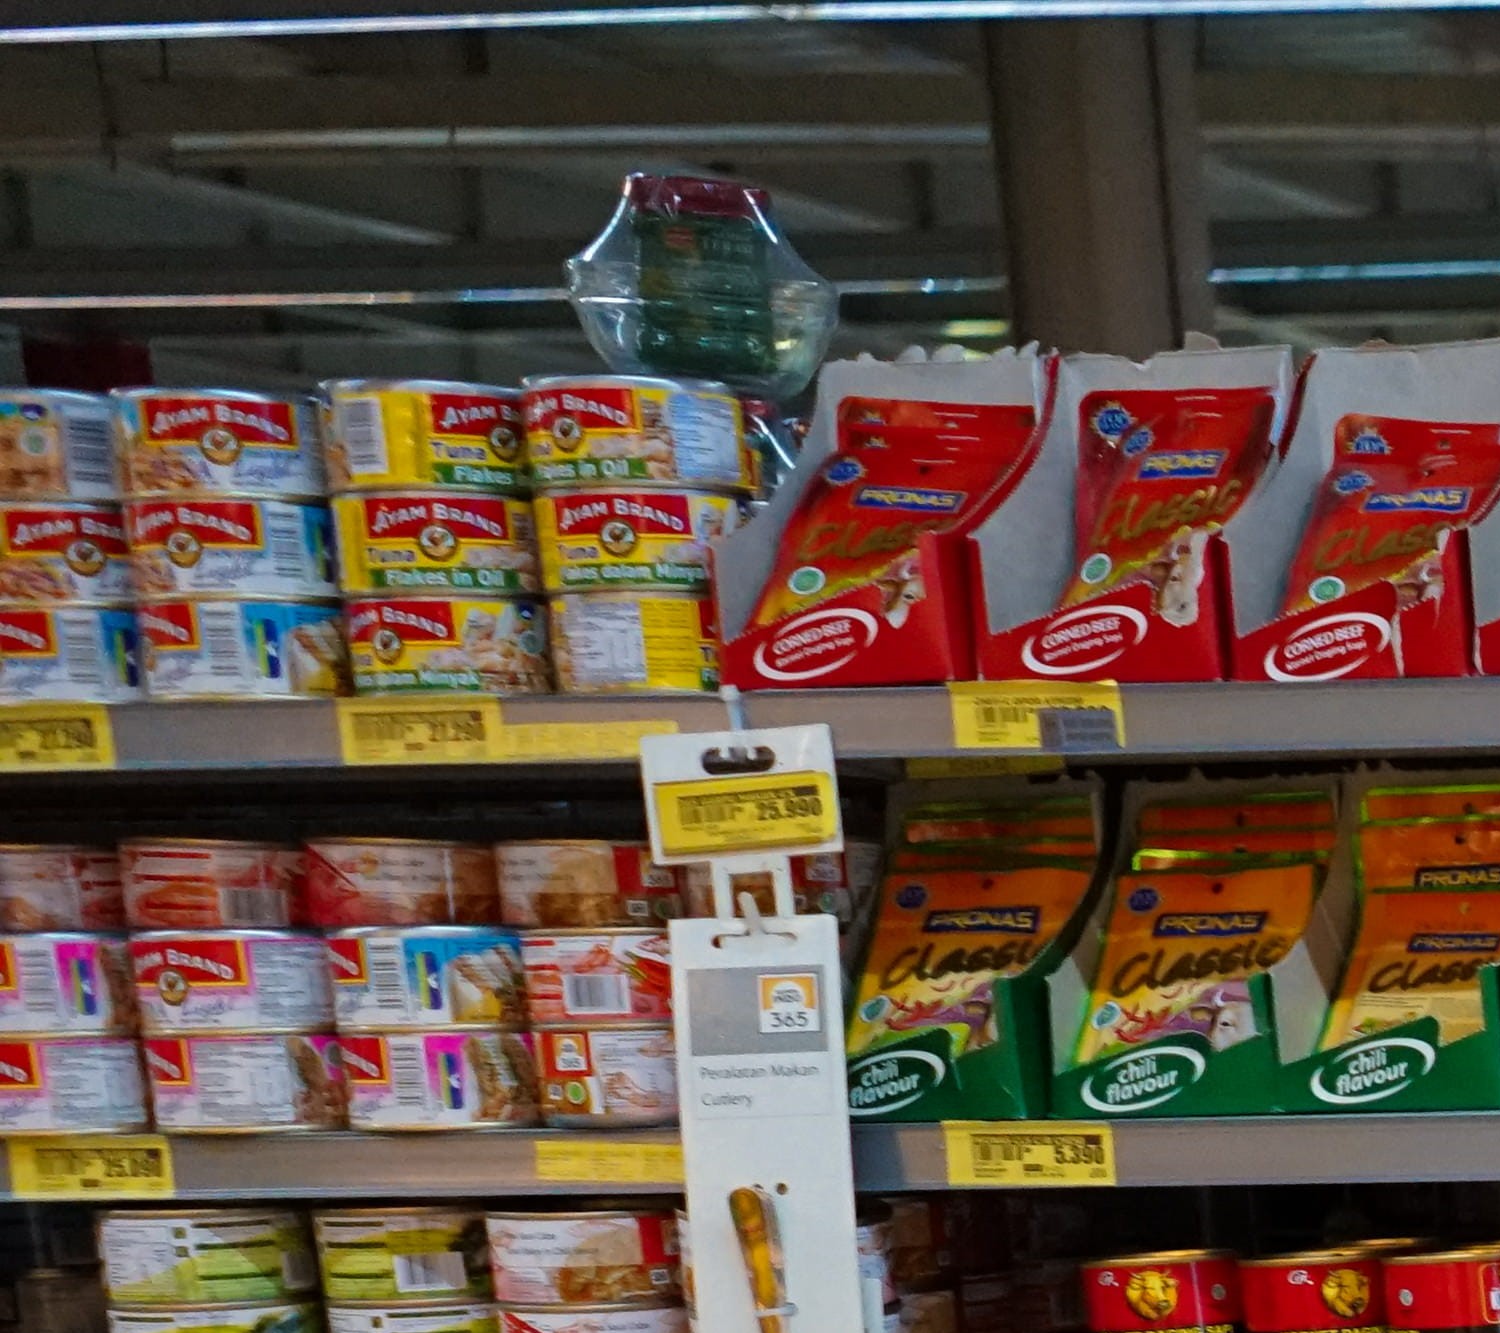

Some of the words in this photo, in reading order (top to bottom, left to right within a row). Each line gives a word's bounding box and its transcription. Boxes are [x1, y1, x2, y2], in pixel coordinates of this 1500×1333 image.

[373, 503, 427, 534] AYAM
[434, 503, 501, 538] BRAND
[770, 1012, 807, 1028] 365
[1118, 1055, 1155, 1082] chili
[1107, 1071, 1179, 1101] flavour
